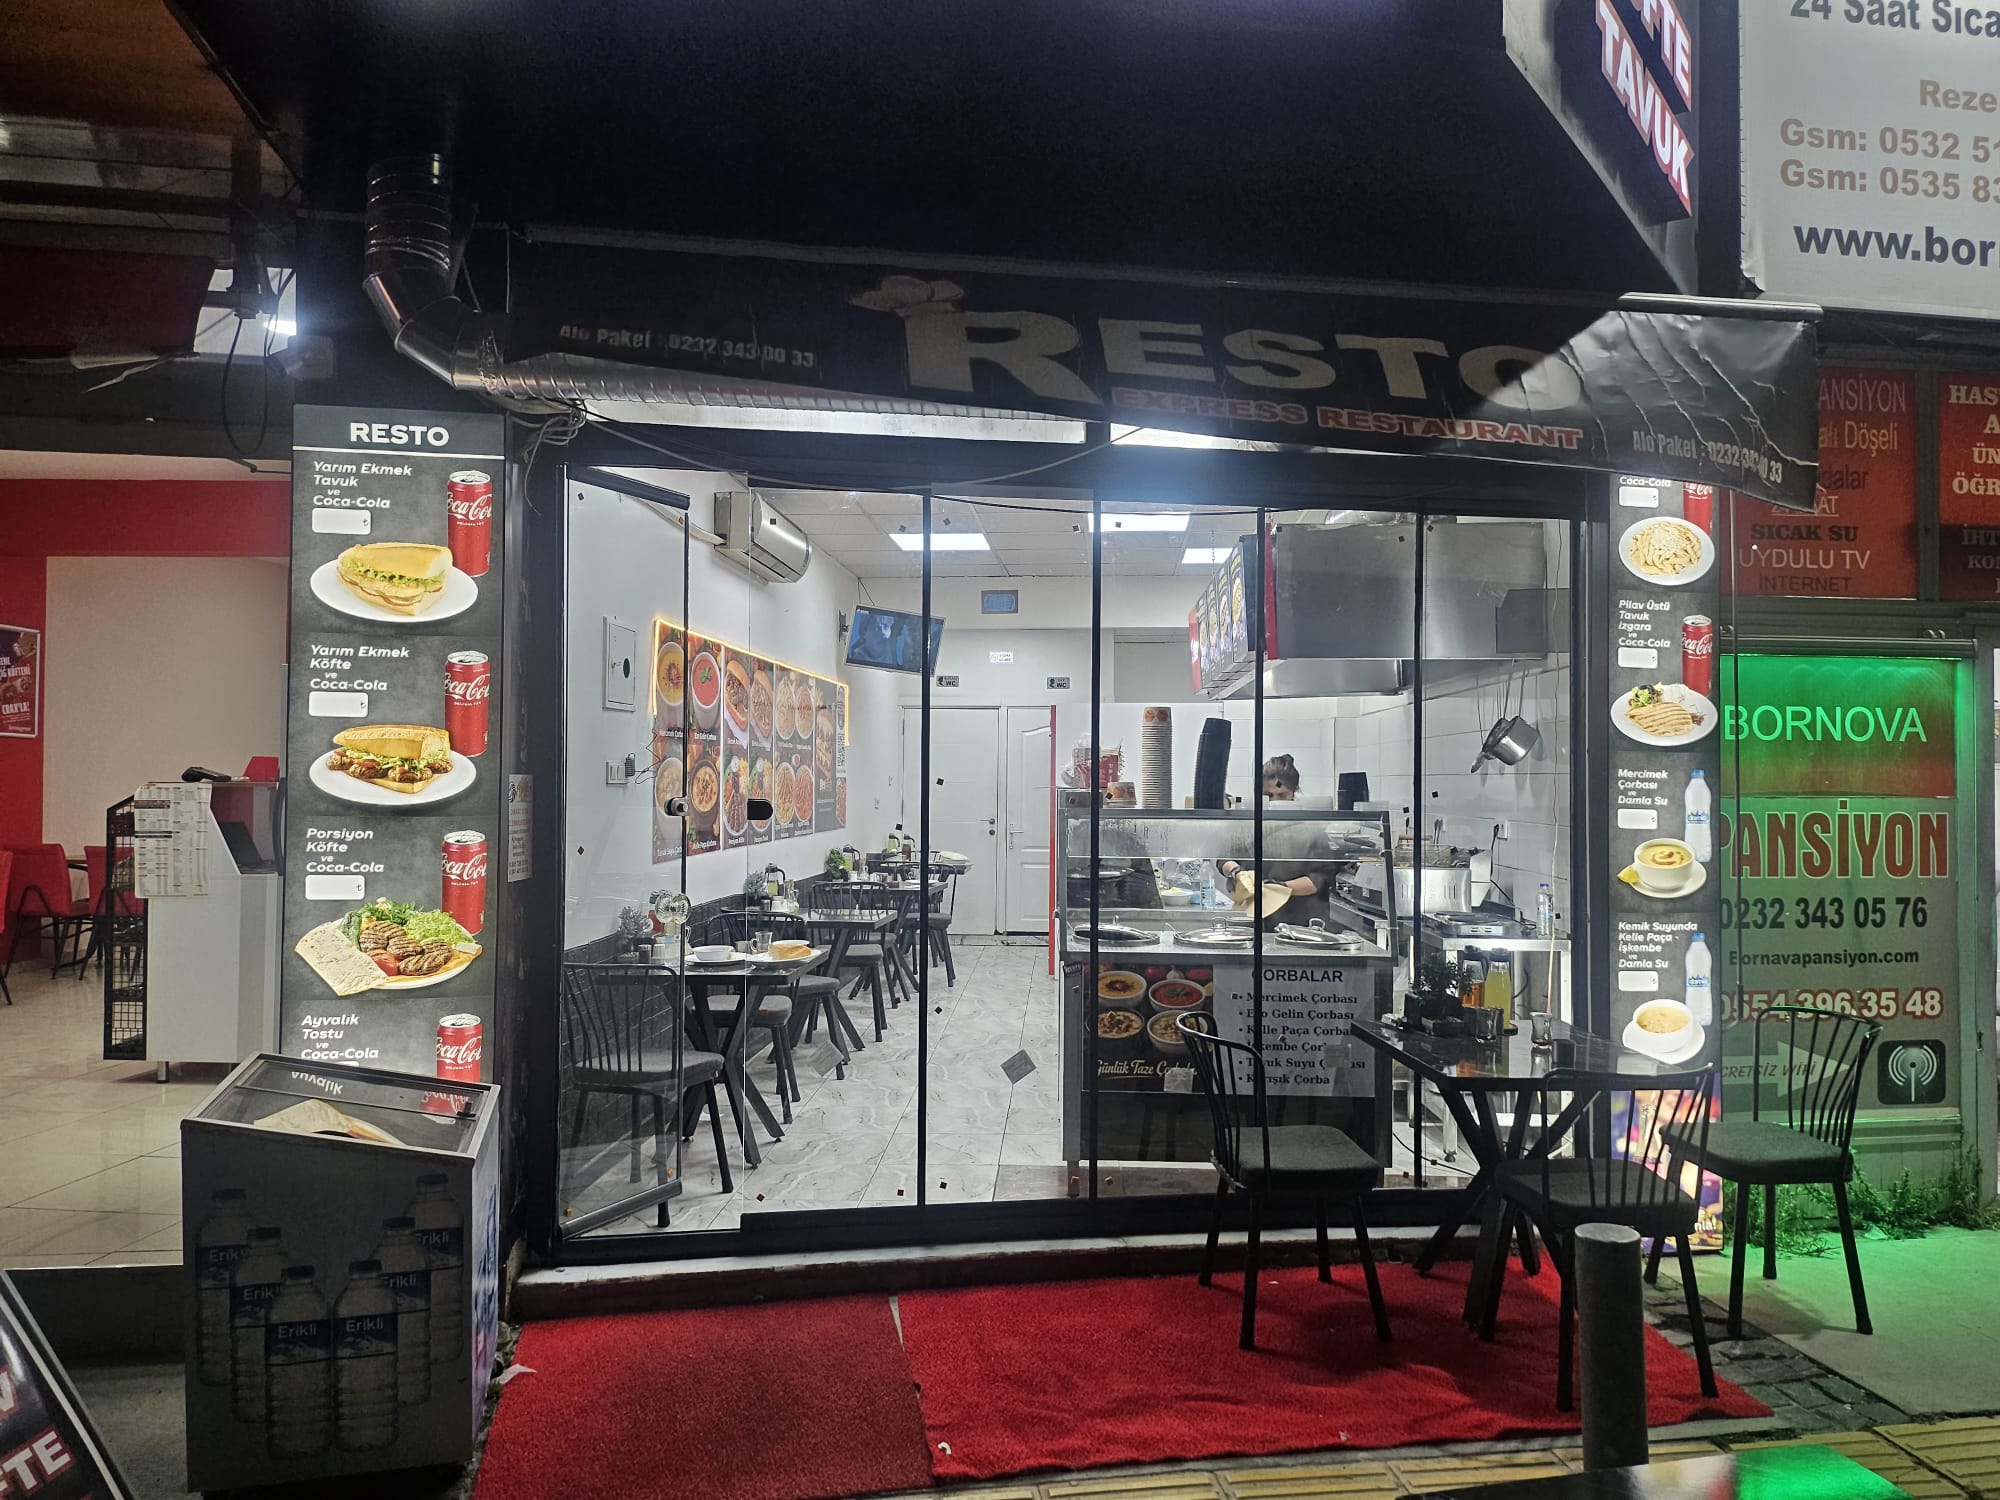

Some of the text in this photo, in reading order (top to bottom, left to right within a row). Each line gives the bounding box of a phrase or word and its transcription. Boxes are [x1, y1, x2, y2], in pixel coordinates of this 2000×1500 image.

[1843, 0, 1920, 30] Saat
[1919, 79, 1998, 113] Reze
[1597, 0, 1692, 211] TAVUK
[1780, 118, 1867, 152] Gsm:
[1879, 126, 1960, 160] 0532
[1780, 159, 1867, 192] Gsm:
[1879, 166, 1960, 200] 0535
[1793, 225, 2000, 268] www.bor
[903, 311, 1577, 411] RESTO
[1819, 373, 1907, 413] ANSİYON
[1949, 384, 2000, 406] HAS
[1112, 386, 1584, 450] EXPRESS RESTAURANT
[350, 422, 450, 447] RESTO
[313, 461, 413, 477] Yarım Ekmek
[313, 474, 359, 488] Tavuk
[1619, 476, 1672, 488] Coca-Cola
[327, 488, 341, 496] ve
[313, 495, 391, 509] Coca-Cola
[1751, 524, 1859, 542] SICAK SU
[1739, 549, 1871, 570] UYDULU TV
[1618, 599, 1670, 611] Pilav Üstü
[1618, 611, 1650, 621] Tavuk
[1618, 637, 1671, 648] Coca-Cola
[310, 644, 410, 659] Yarım Ekmek
[310, 657, 352, 671] Köfte
[324, 671, 338, 680] ve
[310, 678, 388, 692] Coca-Cola
[1724, 704, 1927, 743] BORNOVA
[1617, 768, 1668, 779] Mercimek
[1617, 779, 1658, 791] Çorbası
[1617, 795, 1668, 805] Damla Su
[306, 827, 374, 841] Porsiyon
[306, 841, 348, 853] Köfte
[320, 855, 334, 863] ve
[306, 861, 385, 873] Coca-Cola
[1721, 895, 1928, 929] 0232 343 05 76
[1618, 921, 1698, 934] Kemik Suyunda
[1618, 932, 1673, 944] Kelle Paça
[1618, 941, 1662, 954] İşkembe
[1618, 959, 1669, 969] Damla Su
[1251, 970, 1343, 983] ORBALAR
[1312, 993, 1358, 1004] Çorbası
[1796, 988, 1855, 1021] 396
[1861, 987, 1898, 1018] 35
[1905, 988, 1942, 1017] 48
[301, 1014, 359, 1028] Ayvalık
[1246, 1009, 1354, 1021] Eo Gelin Çorbası
[302, 1028, 344, 1040] Tostu
[1247, 1025, 1351, 1037] Klle Paça Çorba
[315, 1041, 329, 1049] ve
[301, 1048, 379, 1060] Coca-Cola
[1131, 1060, 1154, 1075] Taze
[1286, 1058, 1316, 1070] Suyu
[1293, 1074, 1331, 1086] Çorba
[345, 1315, 385, 1333] Erikli
[277, 1324, 318, 1339] Erikli
